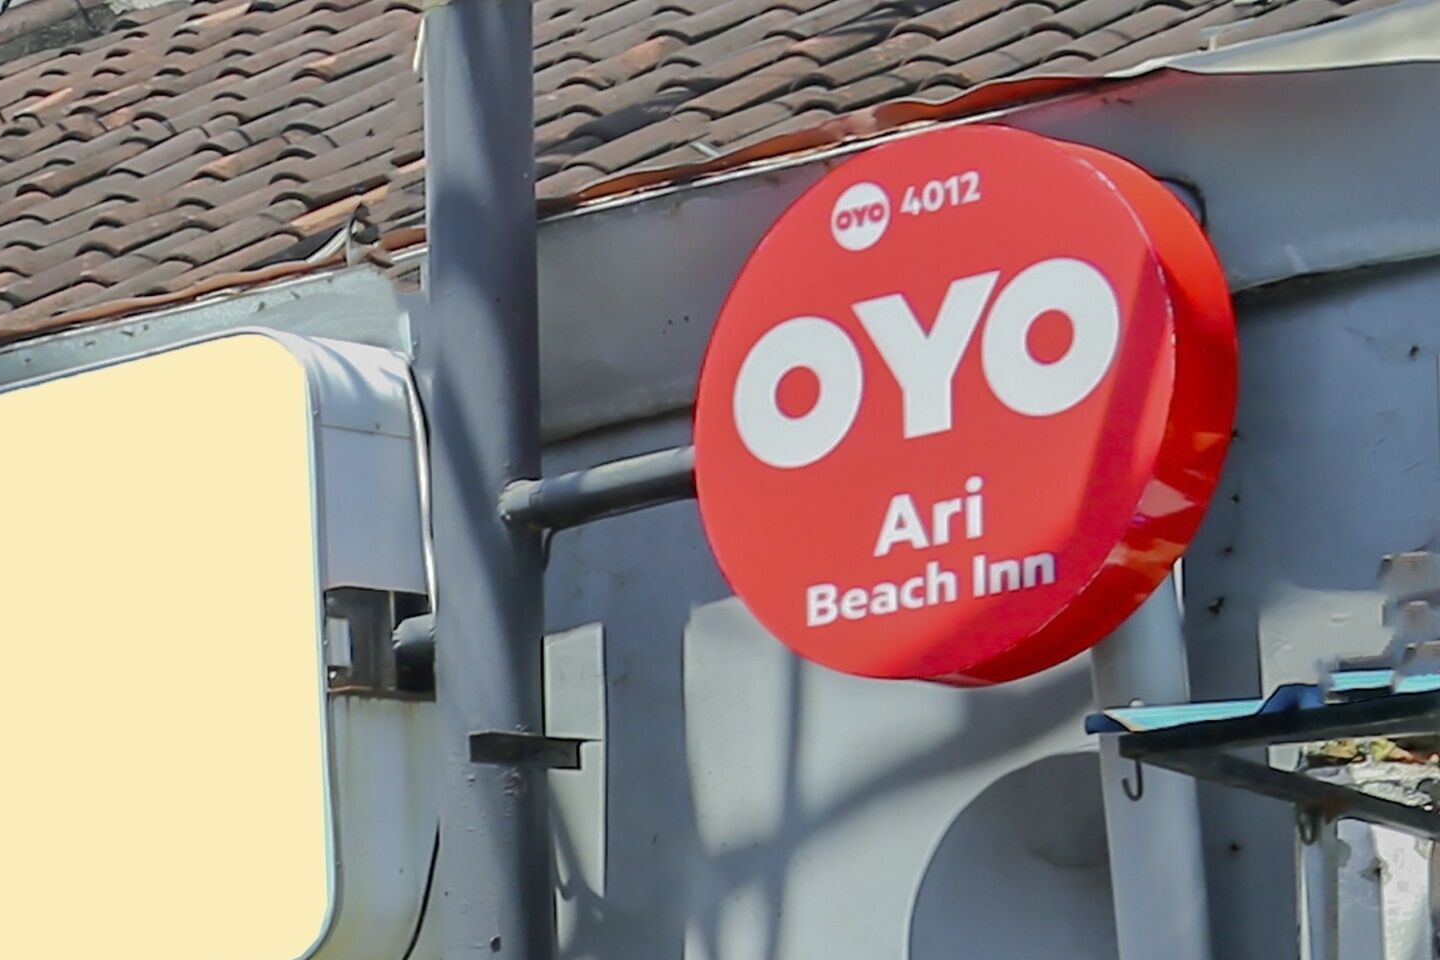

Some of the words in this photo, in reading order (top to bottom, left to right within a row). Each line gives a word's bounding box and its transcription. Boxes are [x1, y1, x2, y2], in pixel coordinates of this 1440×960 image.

[836, 202, 885, 231] OYO
[899, 170, 983, 216] 4012
[732, 256, 1120, 469] OYO
[873, 475, 983, 557] Ari
[806, 561, 958, 627] Beach
[972, 551, 1056, 598] Inn
